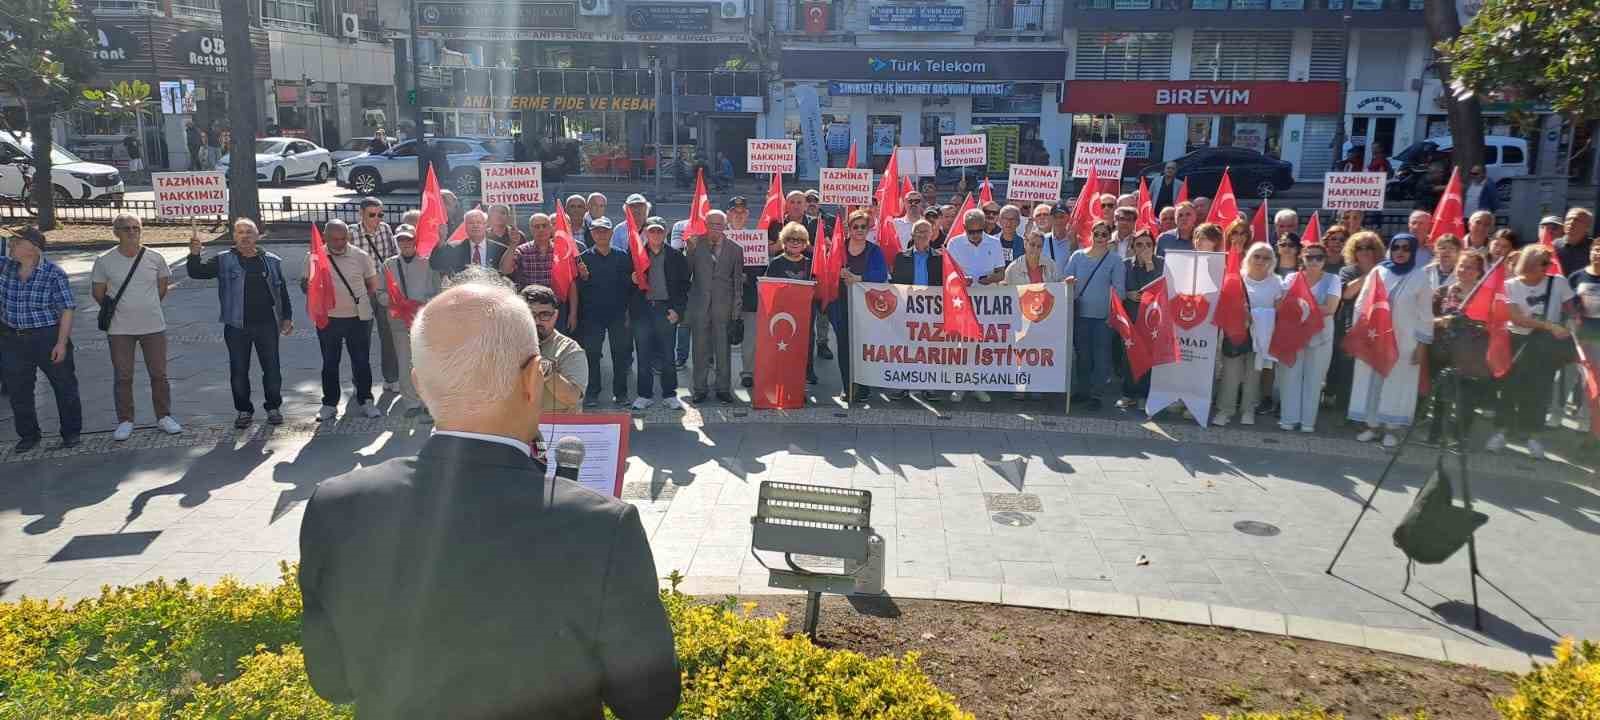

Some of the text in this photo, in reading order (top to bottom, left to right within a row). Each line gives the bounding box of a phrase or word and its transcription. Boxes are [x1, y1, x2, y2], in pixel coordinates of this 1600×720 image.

[200, 36, 226, 55] OB
[189, 51, 227, 66] Restau
[890, 59, 986, 73] Türk Telekom
[502, 96, 551, 110] TERME
[590, 97, 609, 110] VE
[944, 136, 982, 145] TAZMİNAT
[751, 142, 792, 150] TAZMİNAT
[1080, 145, 1121, 154] TAZMİNAT
[944, 147, 983, 156] HAKKIMIZI
[944, 157, 983, 165] İSTİYORUZ
[1077, 157, 1120, 166] HAKKIMIZI
[485, 165, 537, 177] TAZMİNAT
[824, 170, 868, 180] TAZMİNAT
[1013, 168, 1058, 178] TAZMİNAT
[1075, 167, 1119, 177] İSTORUZ
[157, 174, 220, 187] TAZMİNAT
[1012, 180, 1058, 188] HAKKIMIZI
[1328, 175, 1380, 184] TAZMİNAT
[485, 180, 539, 190] HAKKIMIZI
[823, 183, 869, 192] HAKKIMIZI
[160, 190, 224, 200] HAKKIMIZI
[1010, 190, 1057, 200] İSTİYORUZ
[1328, 188, 1381, 197] HAKKIMIZI
[486, 192, 540, 204] İSTİYORUZ
[822, 194, 869, 204] İSTİYORUZ
[1327, 197, 1380, 209] İSTİYORUZ
[161, 204, 225, 215] İSTİYORUZ
[906, 294, 1013, 315] ASTSYLAR
[863, 343, 1054, 367] HAKLARINI İSTİYOR
[883, 369, 1031, 386] SAMSUN İL BAŞKANLIĞI
